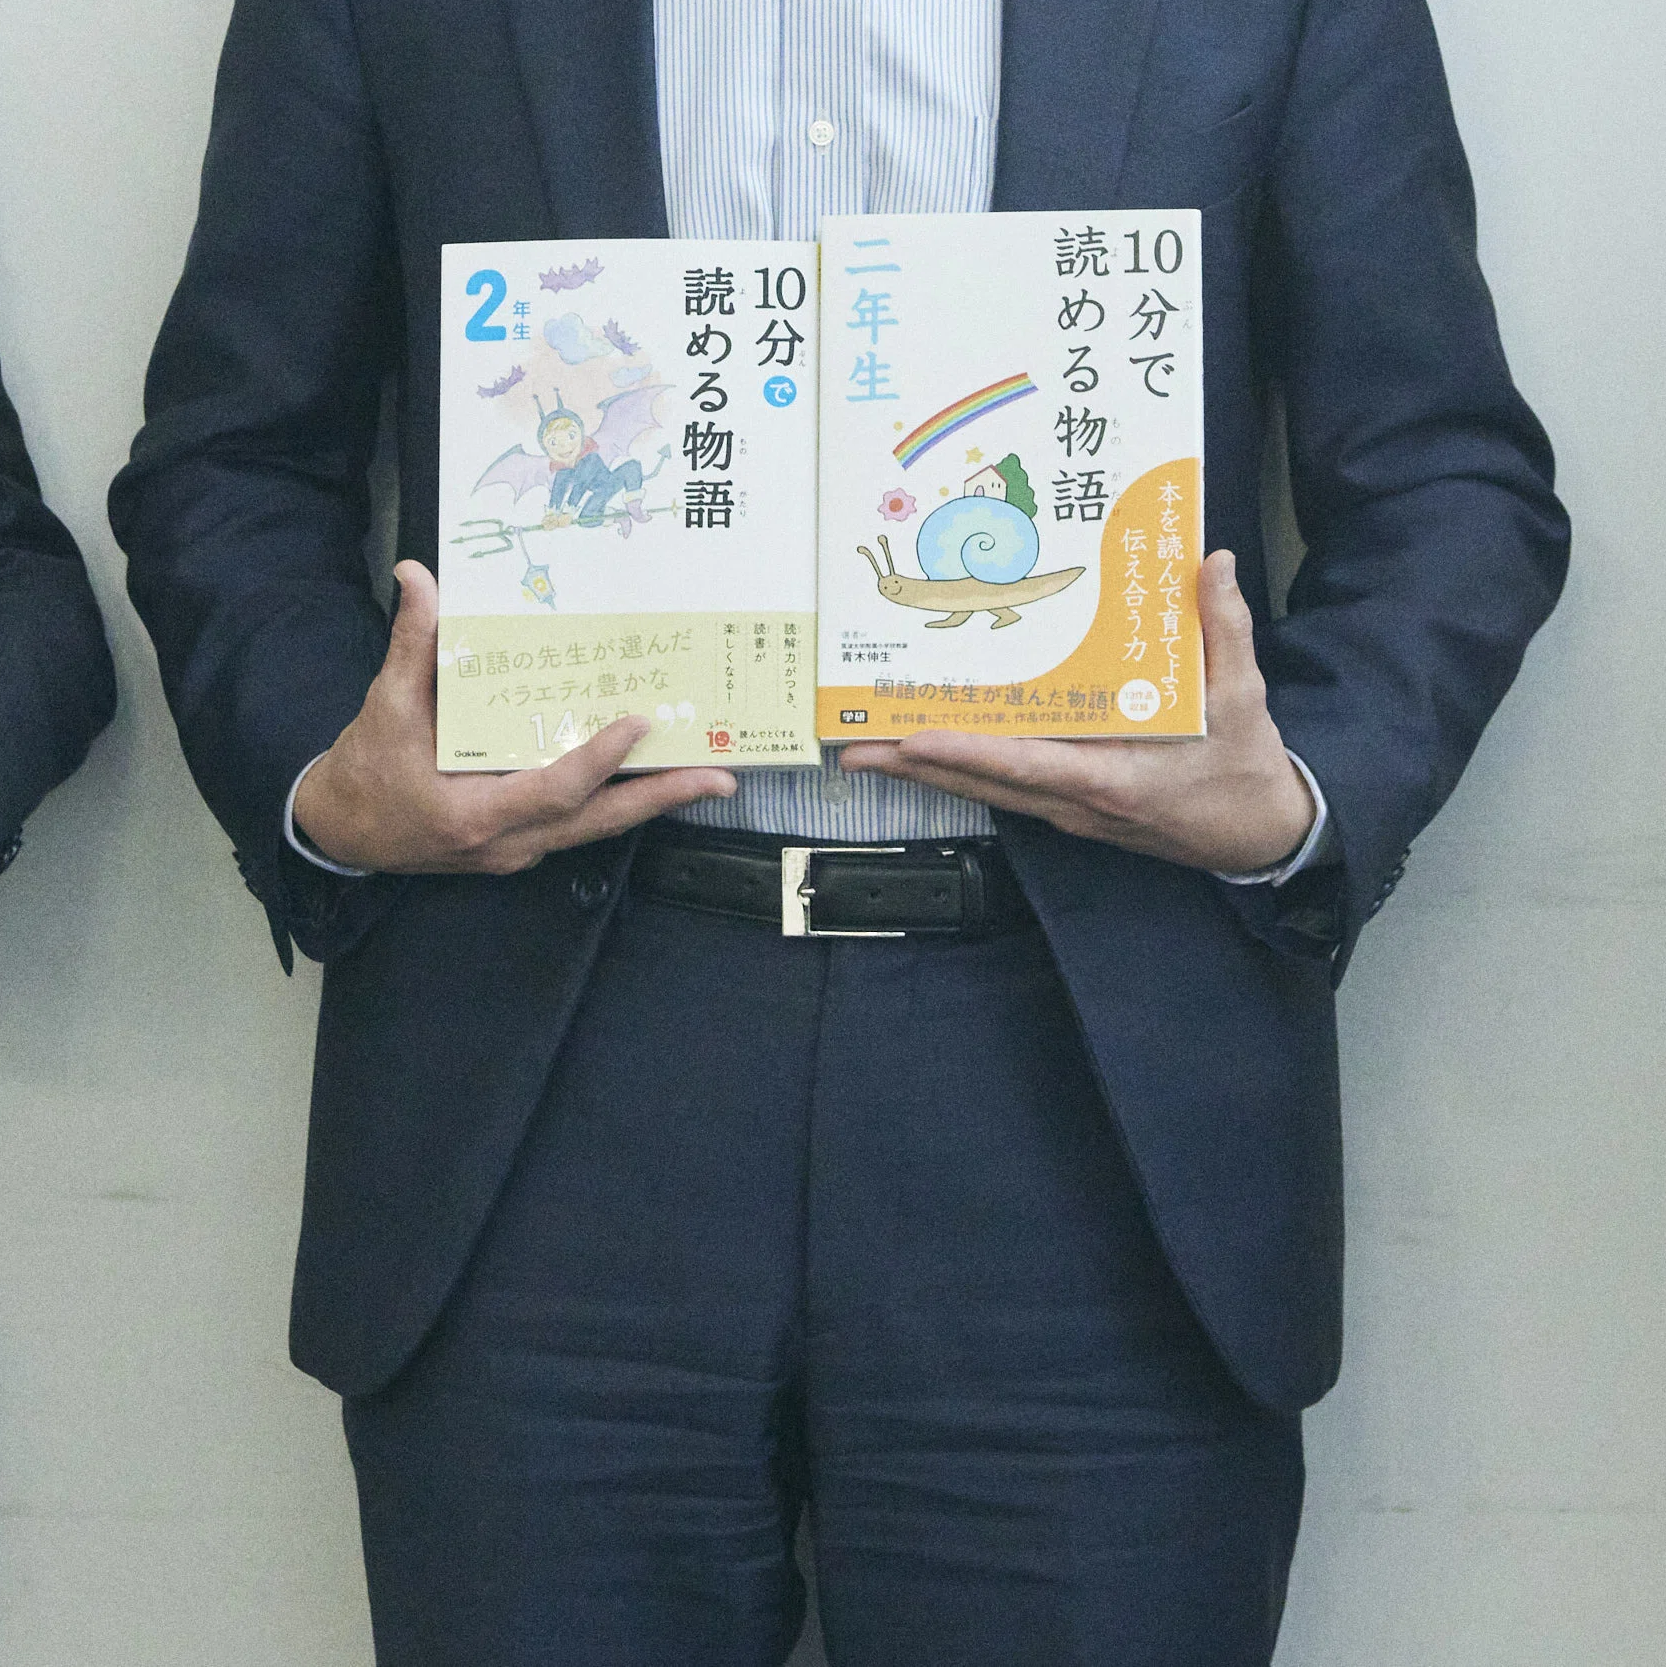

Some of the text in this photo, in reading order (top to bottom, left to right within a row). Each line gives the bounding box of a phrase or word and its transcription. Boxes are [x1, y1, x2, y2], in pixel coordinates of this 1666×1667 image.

[753, 267, 806, 404] 10分で
[845, 239, 902, 402] 二年生
[1052, 225, 1110, 522] 読める物語
[1123, 229, 1183, 398] 10分で
[682, 266, 735, 529] 読める物語
[458, 629, 693, 678] 国語の先生が選んだ
[841, 650, 892, 663] 青木伸生
[1121, 527, 1148, 662] 伝え合う力
[1157, 481, 1185, 710] 本を読んで育てよう
[454, 750, 487, 758] Gakken
[487, 668, 669, 706] バラエティ豊かな
[841, 710, 866, 723] 学研
[874, 678, 1116, 711] 国語の先生が選んだ物語!
